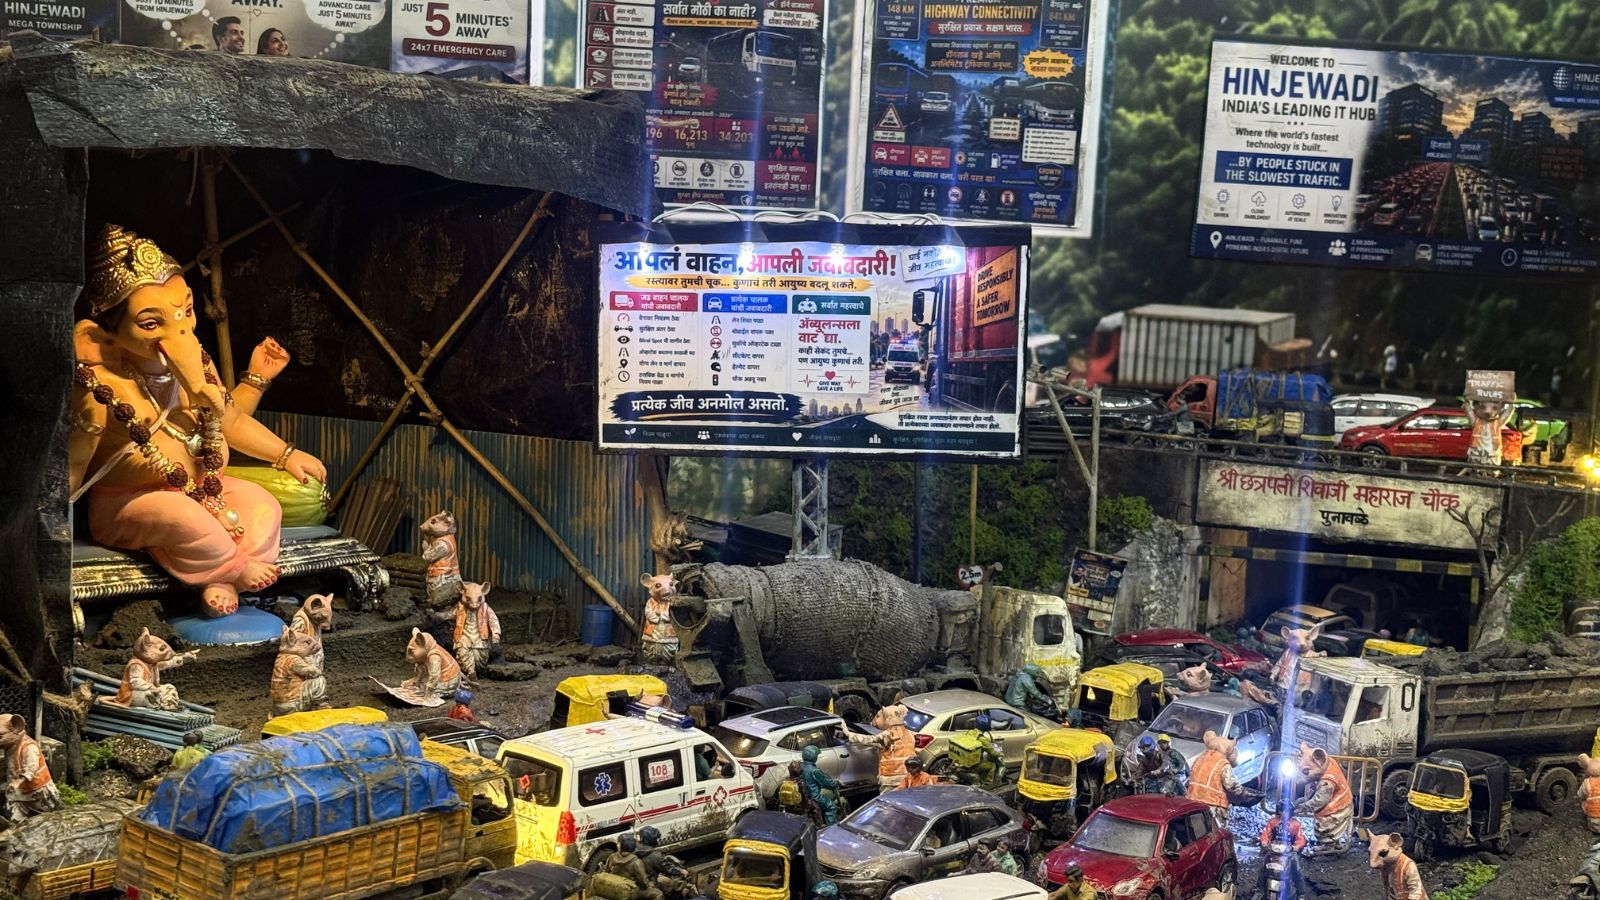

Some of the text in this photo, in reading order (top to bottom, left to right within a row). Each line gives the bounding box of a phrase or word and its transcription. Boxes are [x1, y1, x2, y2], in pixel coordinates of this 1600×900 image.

[5, 2, 86, 18] HINJEWADI
[319, 1, 371, 11] ADVANCED CARE
[401, 3, 423, 13] JUST
[690, 2, 712, 16] मोठी
[713, 5, 727, 16] का
[729, 3, 756, 18] नाही?
[888, 4, 914, 14] 148 KM
[924, 4, 1038, 19] HIGHWAY CONNECTIVITY
[335, 10, 342, 19] 5
[343, 12, 372, 20] MINUTES
[425, 1, 451, 37] 5
[36, 21, 82, 31] TOWNSHIP
[455, 26, 490, 39] AWAY
[938, 21, 961, 34] सुरक्षित
[985, 24, 1004, 32] सक्षम
[1005, 24, 1024, 32] भारत.
[411, 42, 508, 58] 24x7 EMERGENCY CARE
[1270, 54, 1335, 68] WELCOME TO
[1223, 67, 1379, 103] HINJEWADI
[1574, 73, 1600, 83] HINJE
[1222, 99, 1376, 121] INDIA'S LEADING IT HUB
[675, 129, 708, 141] 16,213
[1235, 127, 1339, 142] Where the world's fastest
[1246, 140, 1291, 152] technology
[1293, 141, 1300, 150] is
[1229, 156, 1340, 173] ...BY PEOPLE STUCK IN
[1225, 169, 1342, 186] THE SLOWEST TRAFFIC.
[1356, 246, 1393, 255] PROFESSIONALS
[614, 246, 681, 272] आपलं
[685, 251, 744, 275] वाहन,
[746, 248, 804, 273] आपली
[1361, 254, 1384, 262] GROWING
[977, 265, 993, 283] DRIVE
[646, 277, 678, 286] रस्त्यावर
[680, 275, 704, 288] तुमची
[706, 278, 730, 288] चूक...
[762, 276, 777, 288] तरी
[778, 278, 808, 290] आयुष्य
[809, 279, 829, 291] बदलू
[831, 279, 857, 290] शकते.
[976, 291, 999, 309] A SAFER
[976, 299, 1011, 321] TOMORROW
[798, 333, 819, 343] वाट
[798, 346, 812, 354] काही
[810, 357, 830, 366] आयुष्य
[852, 357, 865, 366] तरी.
[1468, 379, 1504, 388] TRAFFIC
[631, 394, 789, 411] प्रत्येक जीव अनमोल असतो.
[1217, 468, 1461, 512] श्री छत्रपती शिवाजी महाराज चौक
[1319, 508, 1369, 527] पुनावळे
[651, 764, 668, 776] 108
[593, 819, 619, 828] AMBULANCE
